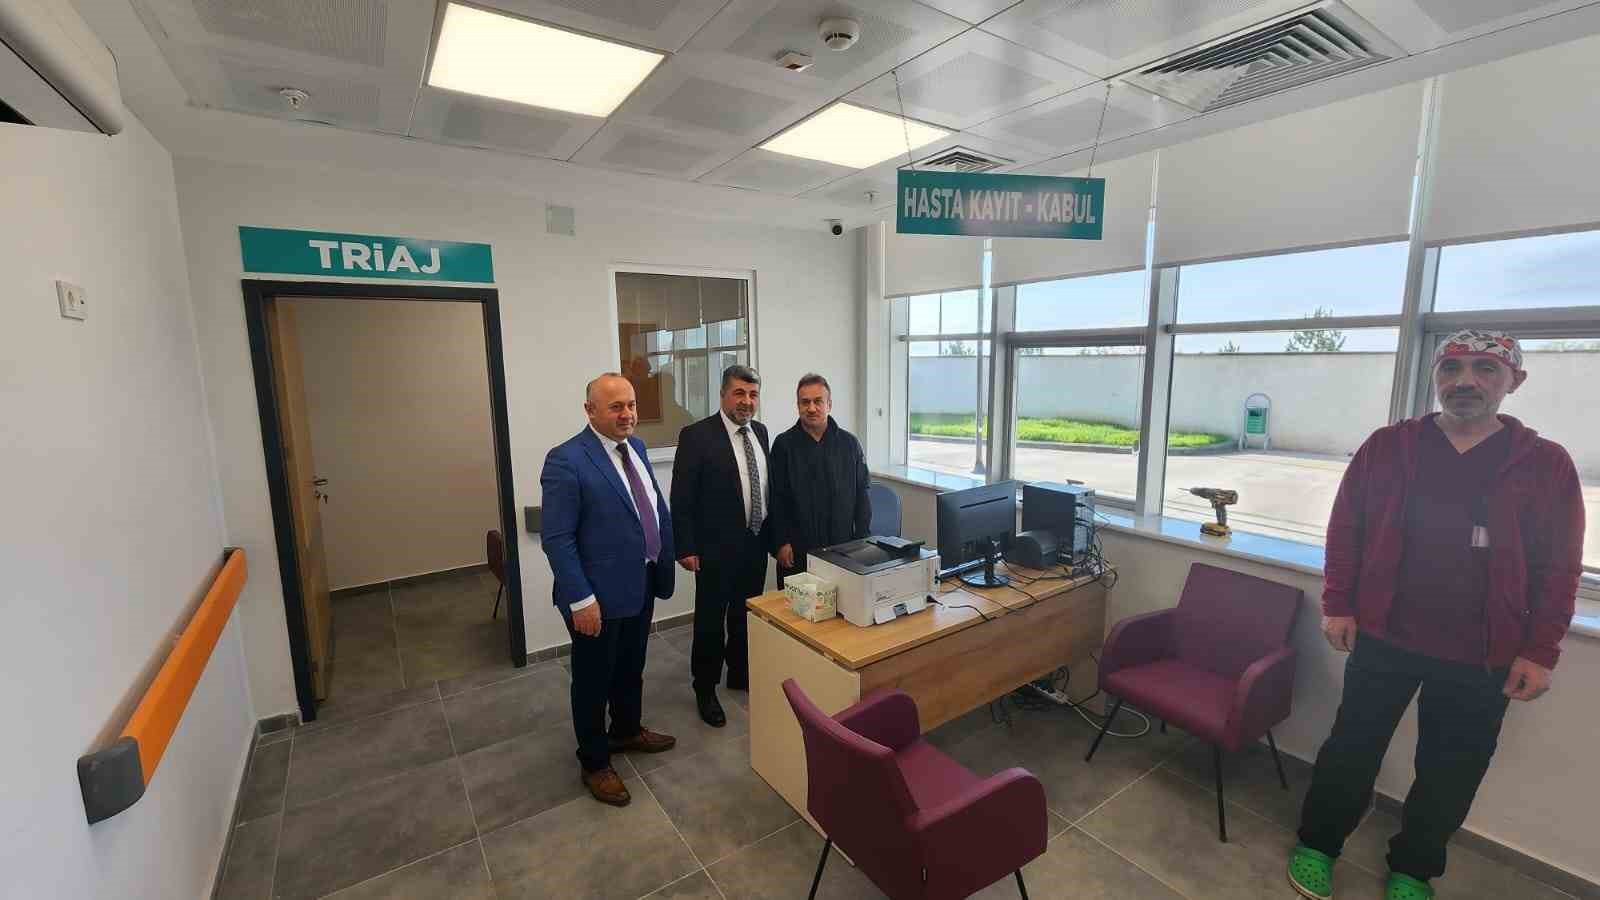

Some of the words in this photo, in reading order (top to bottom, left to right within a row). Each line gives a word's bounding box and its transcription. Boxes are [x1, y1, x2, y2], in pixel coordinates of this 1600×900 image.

[904, 187, 964, 219] HASTA
[969, 190, 1023, 221] KAYIT
[1037, 193, 1095, 224] KABUL
